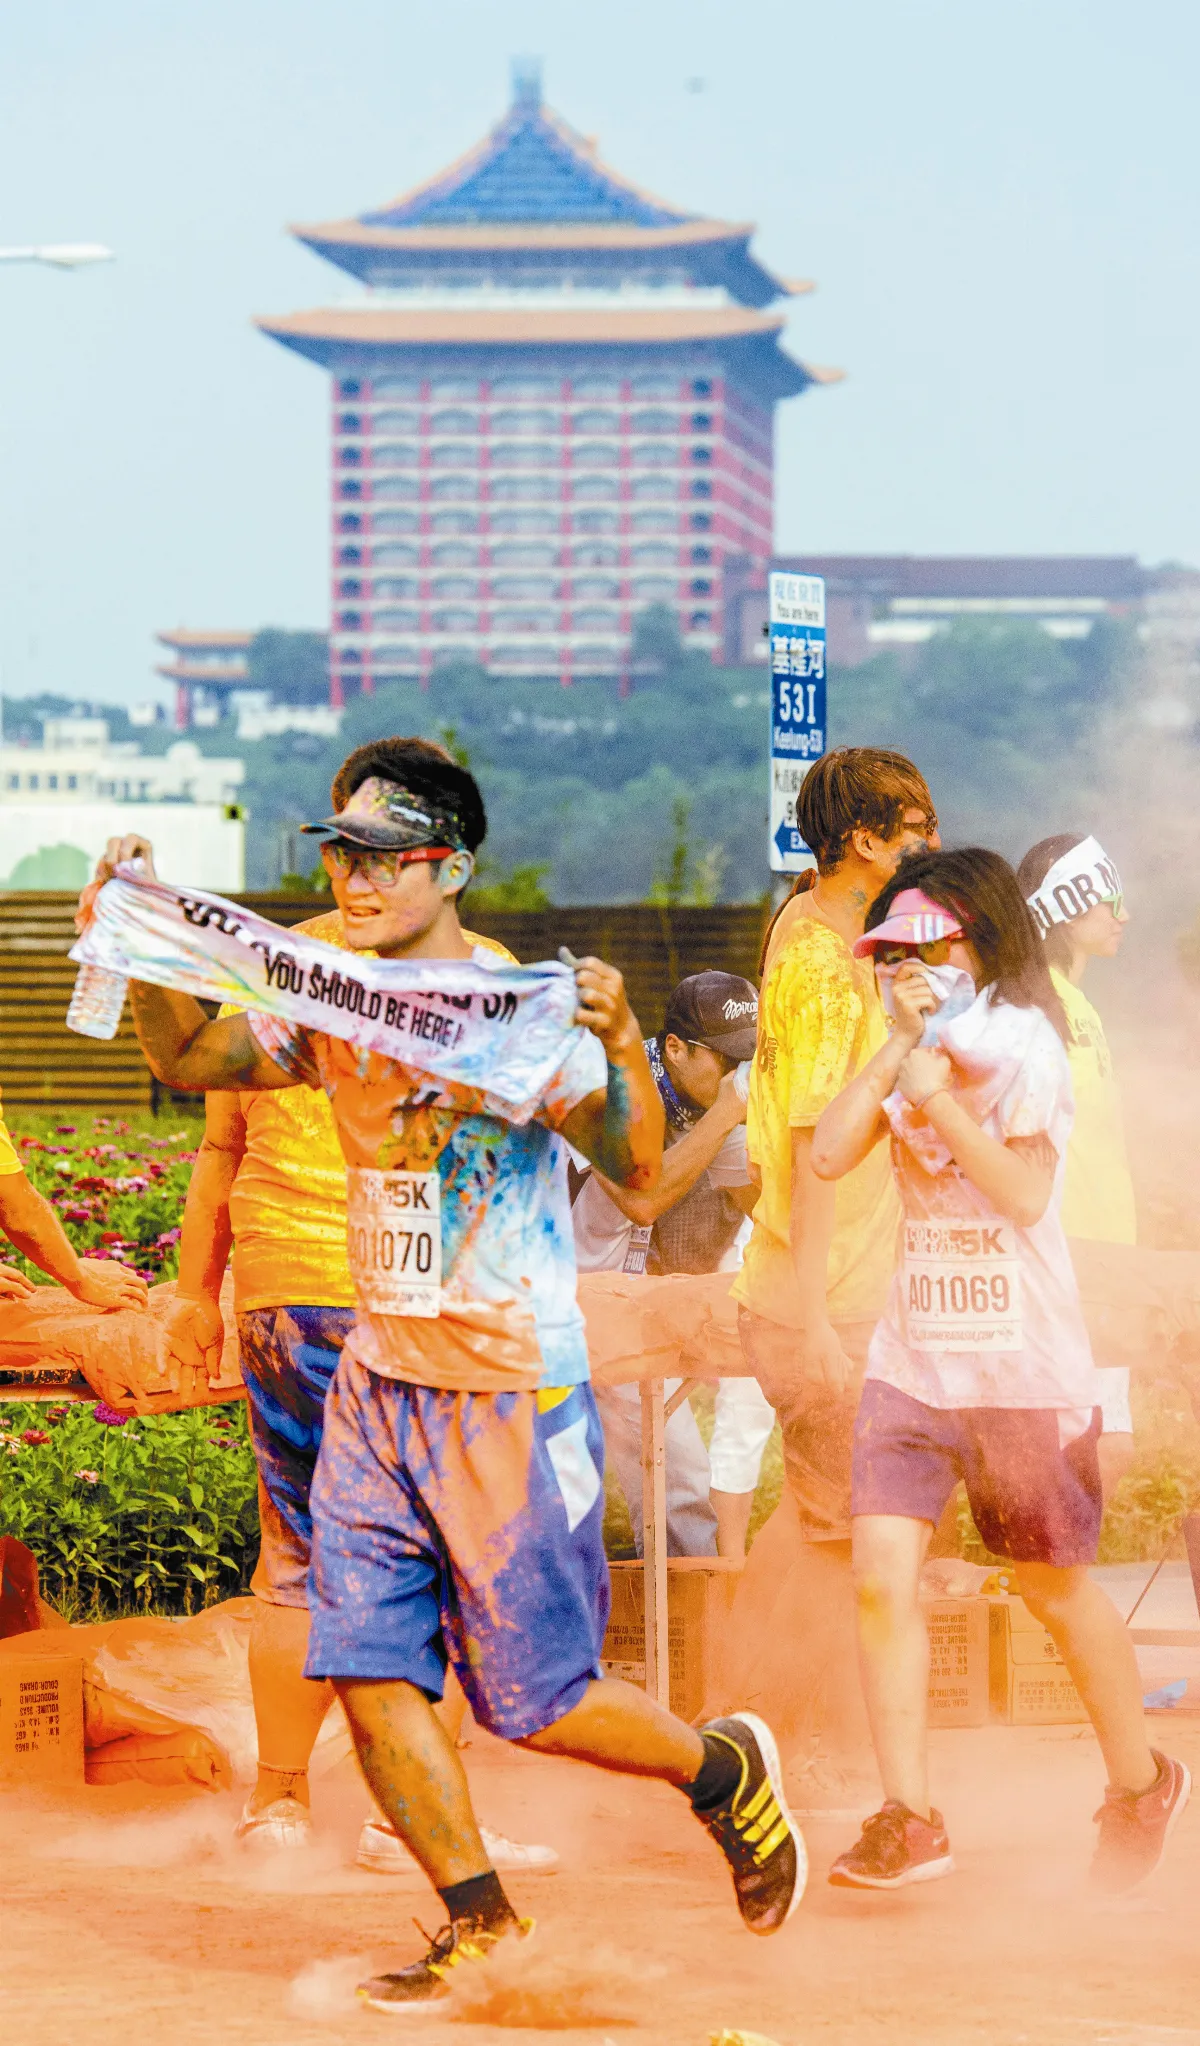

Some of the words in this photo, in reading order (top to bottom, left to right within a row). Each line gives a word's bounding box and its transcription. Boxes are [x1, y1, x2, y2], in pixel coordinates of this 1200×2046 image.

[777, 604, 789, 618] You
[791, 608, 802, 620] are
[804, 607, 819, 622] here
[772, 634, 825, 679] 基隆河
[264, 956, 304, 995] YOU
[308, 972, 382, 1020] SHOULD
[384, 996, 410, 1031] BE
[385, 1178, 431, 1211] 5K
[953, 1227, 1007, 1257] 5K
[909, 1274, 1010, 1314] A01069
